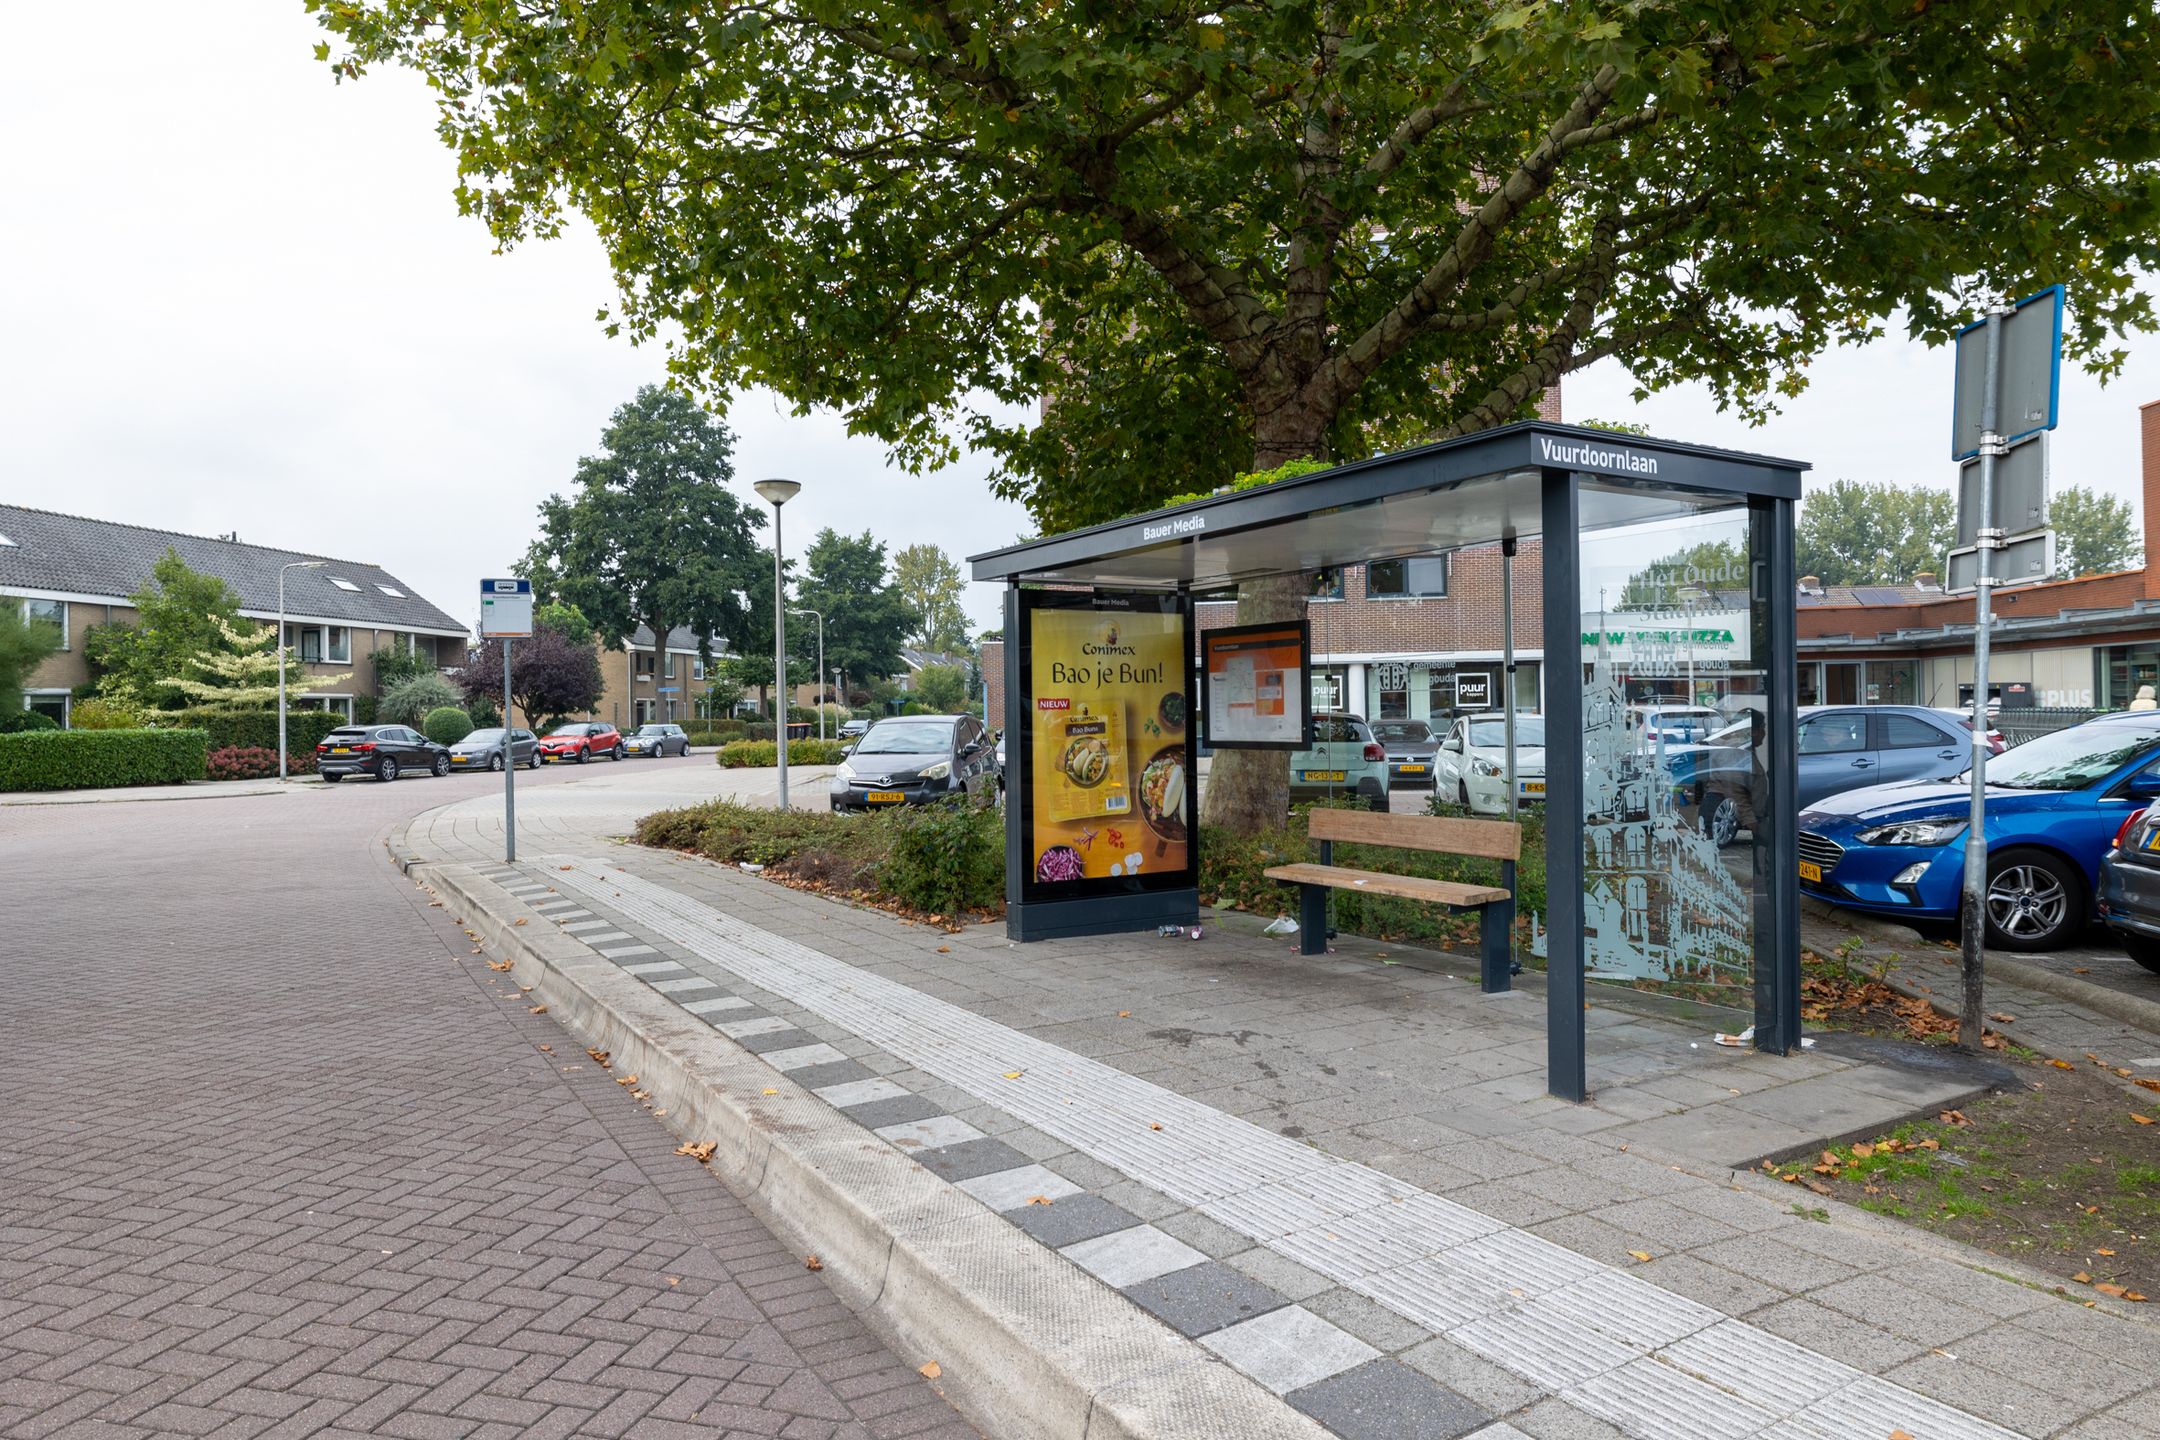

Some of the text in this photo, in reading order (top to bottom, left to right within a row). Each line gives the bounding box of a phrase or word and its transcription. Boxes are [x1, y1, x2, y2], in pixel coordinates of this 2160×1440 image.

[1540, 438, 1658, 474] Vuurdoornlaan
[1143, 515, 1206, 541] Bauer Media
[1683, 557, 1745, 586] Oude
[1082, 642, 1136, 656] Conimex
[1700, 657, 1730, 672] gouda
[1052, 661, 1164, 689] Bao je Bun!
[1460, 683, 1486, 695] puur
[1040, 700, 1069, 709] NIEUW
[2047, 689, 2092, 708] PLUS
[870, 792, 902, 801] 91-RSJ-6
